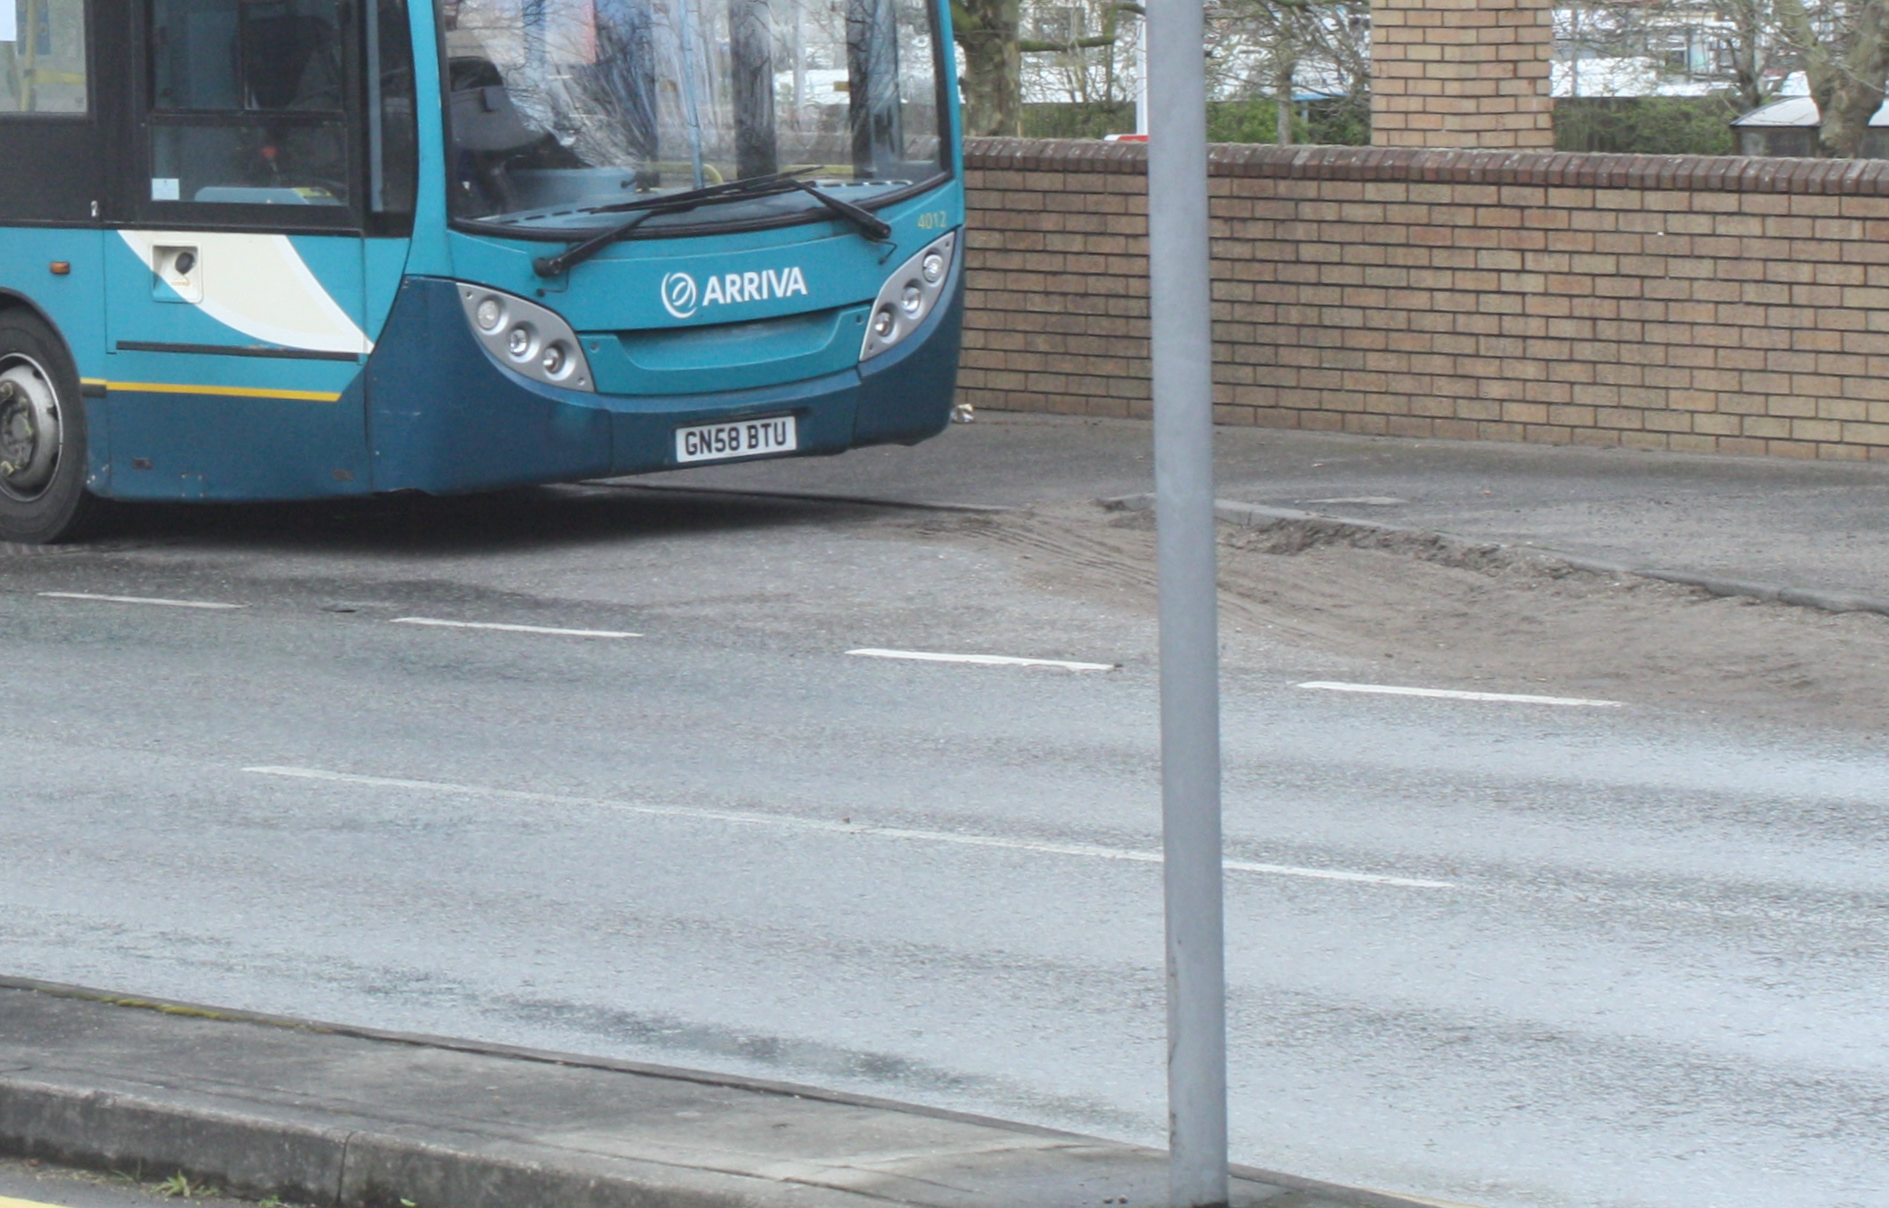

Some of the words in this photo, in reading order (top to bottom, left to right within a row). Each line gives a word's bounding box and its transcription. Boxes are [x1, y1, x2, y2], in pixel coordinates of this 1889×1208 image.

[702, 265, 808, 307] ARRIVA
[685, 425, 740, 456] GN58
[747, 421, 786, 449] BTU
